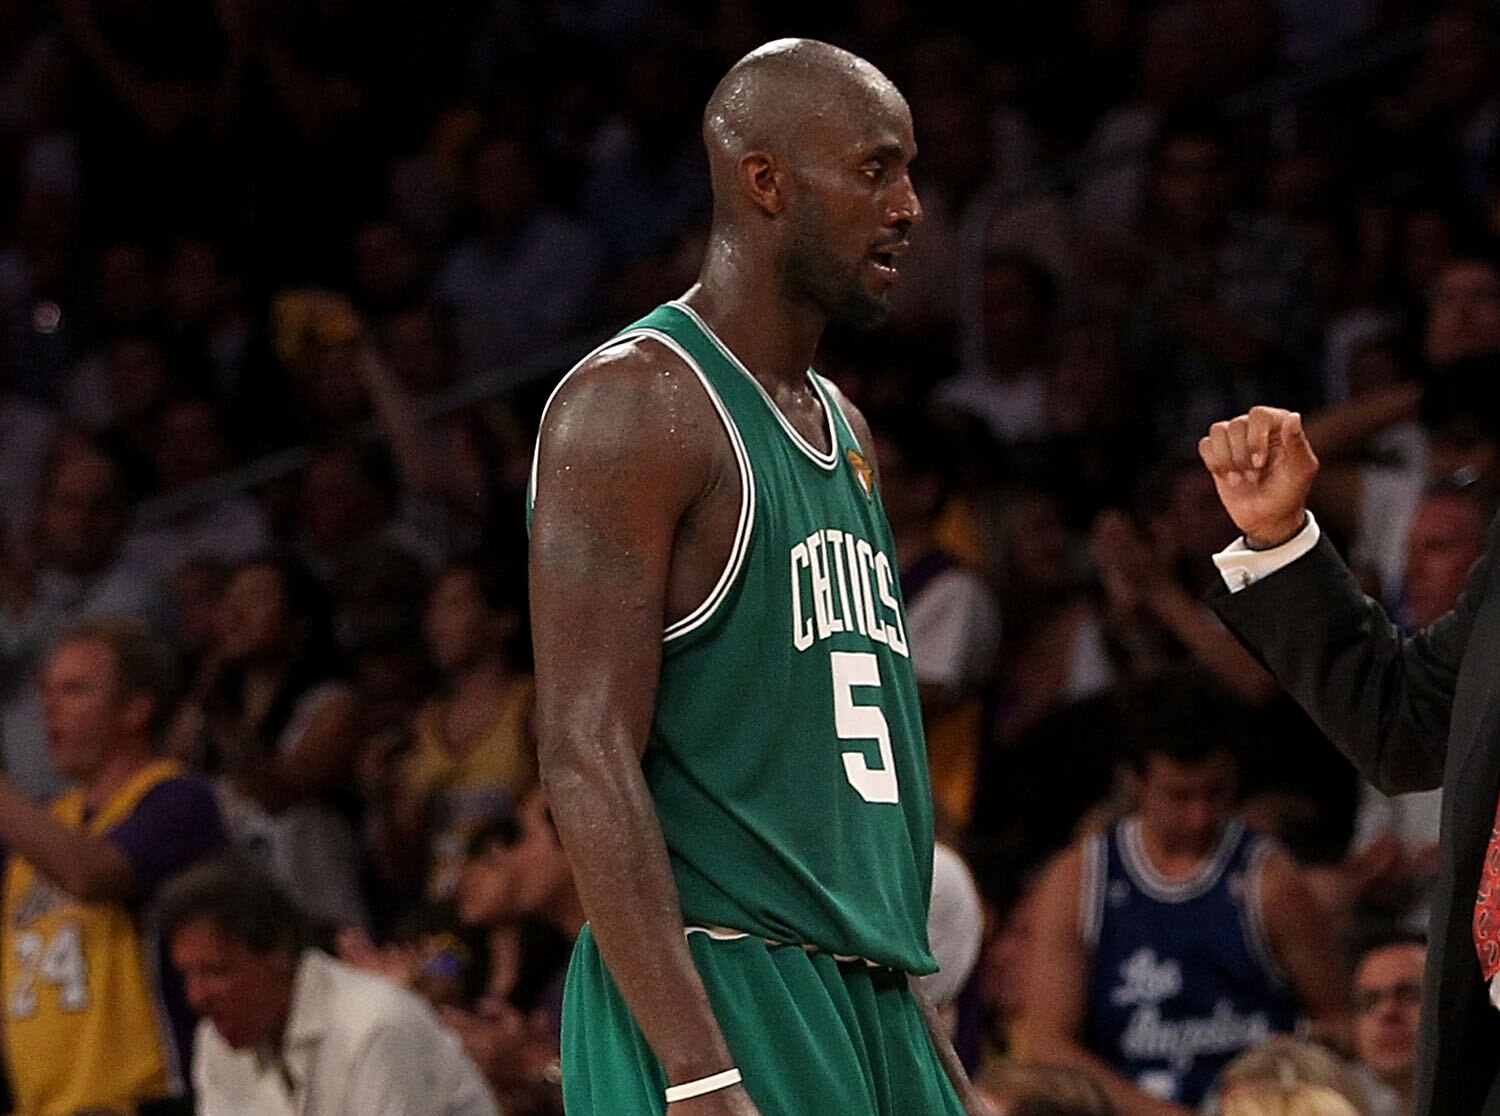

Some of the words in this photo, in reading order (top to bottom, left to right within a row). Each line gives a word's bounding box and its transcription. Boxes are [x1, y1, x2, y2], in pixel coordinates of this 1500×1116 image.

[790, 529, 909, 658] CELTICS
[830, 651, 899, 804] 5
[9, 925, 89, 1018] 24
